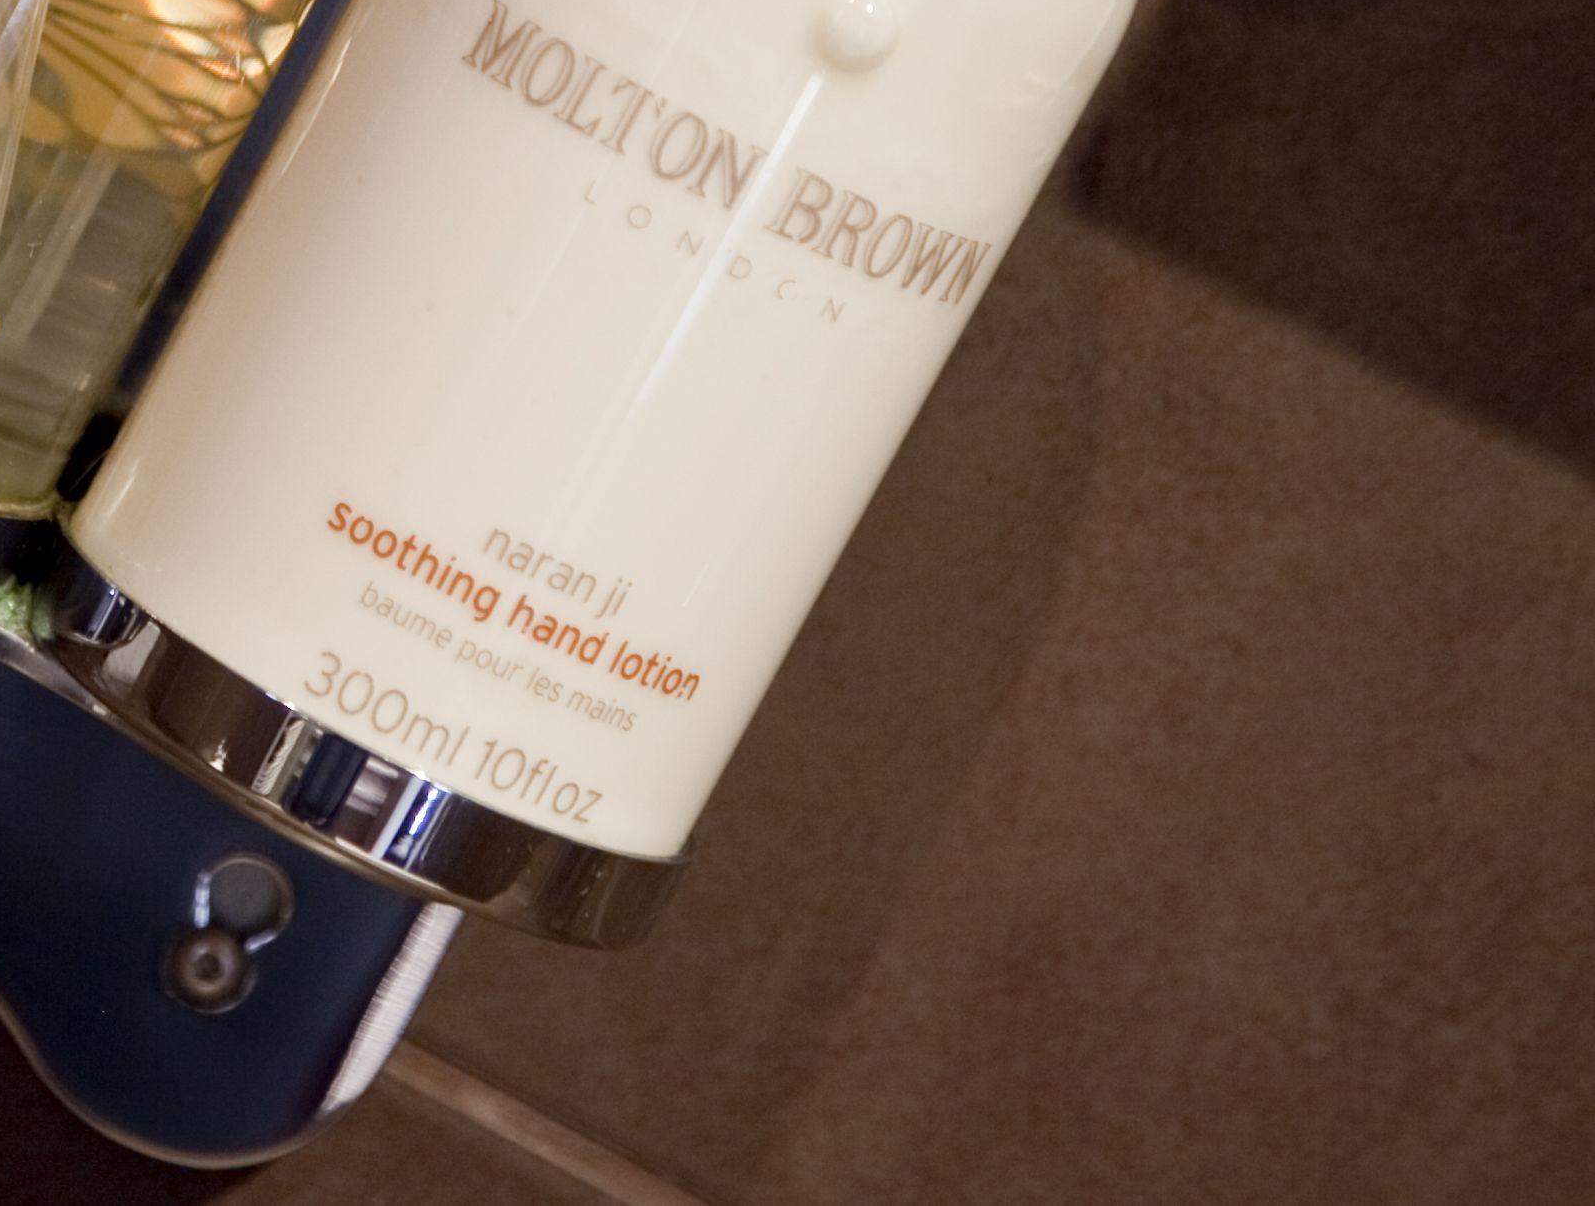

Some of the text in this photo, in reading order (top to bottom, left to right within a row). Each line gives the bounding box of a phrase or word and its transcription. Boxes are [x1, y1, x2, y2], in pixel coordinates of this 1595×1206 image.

[765, 167, 993, 304] BROWN
[326, 501, 702, 702] soothing hand lotion
[482, 527, 634, 620] naran ji
[303, 650, 471, 767] 300ml
[358, 579, 638, 733] baume pour les mains
